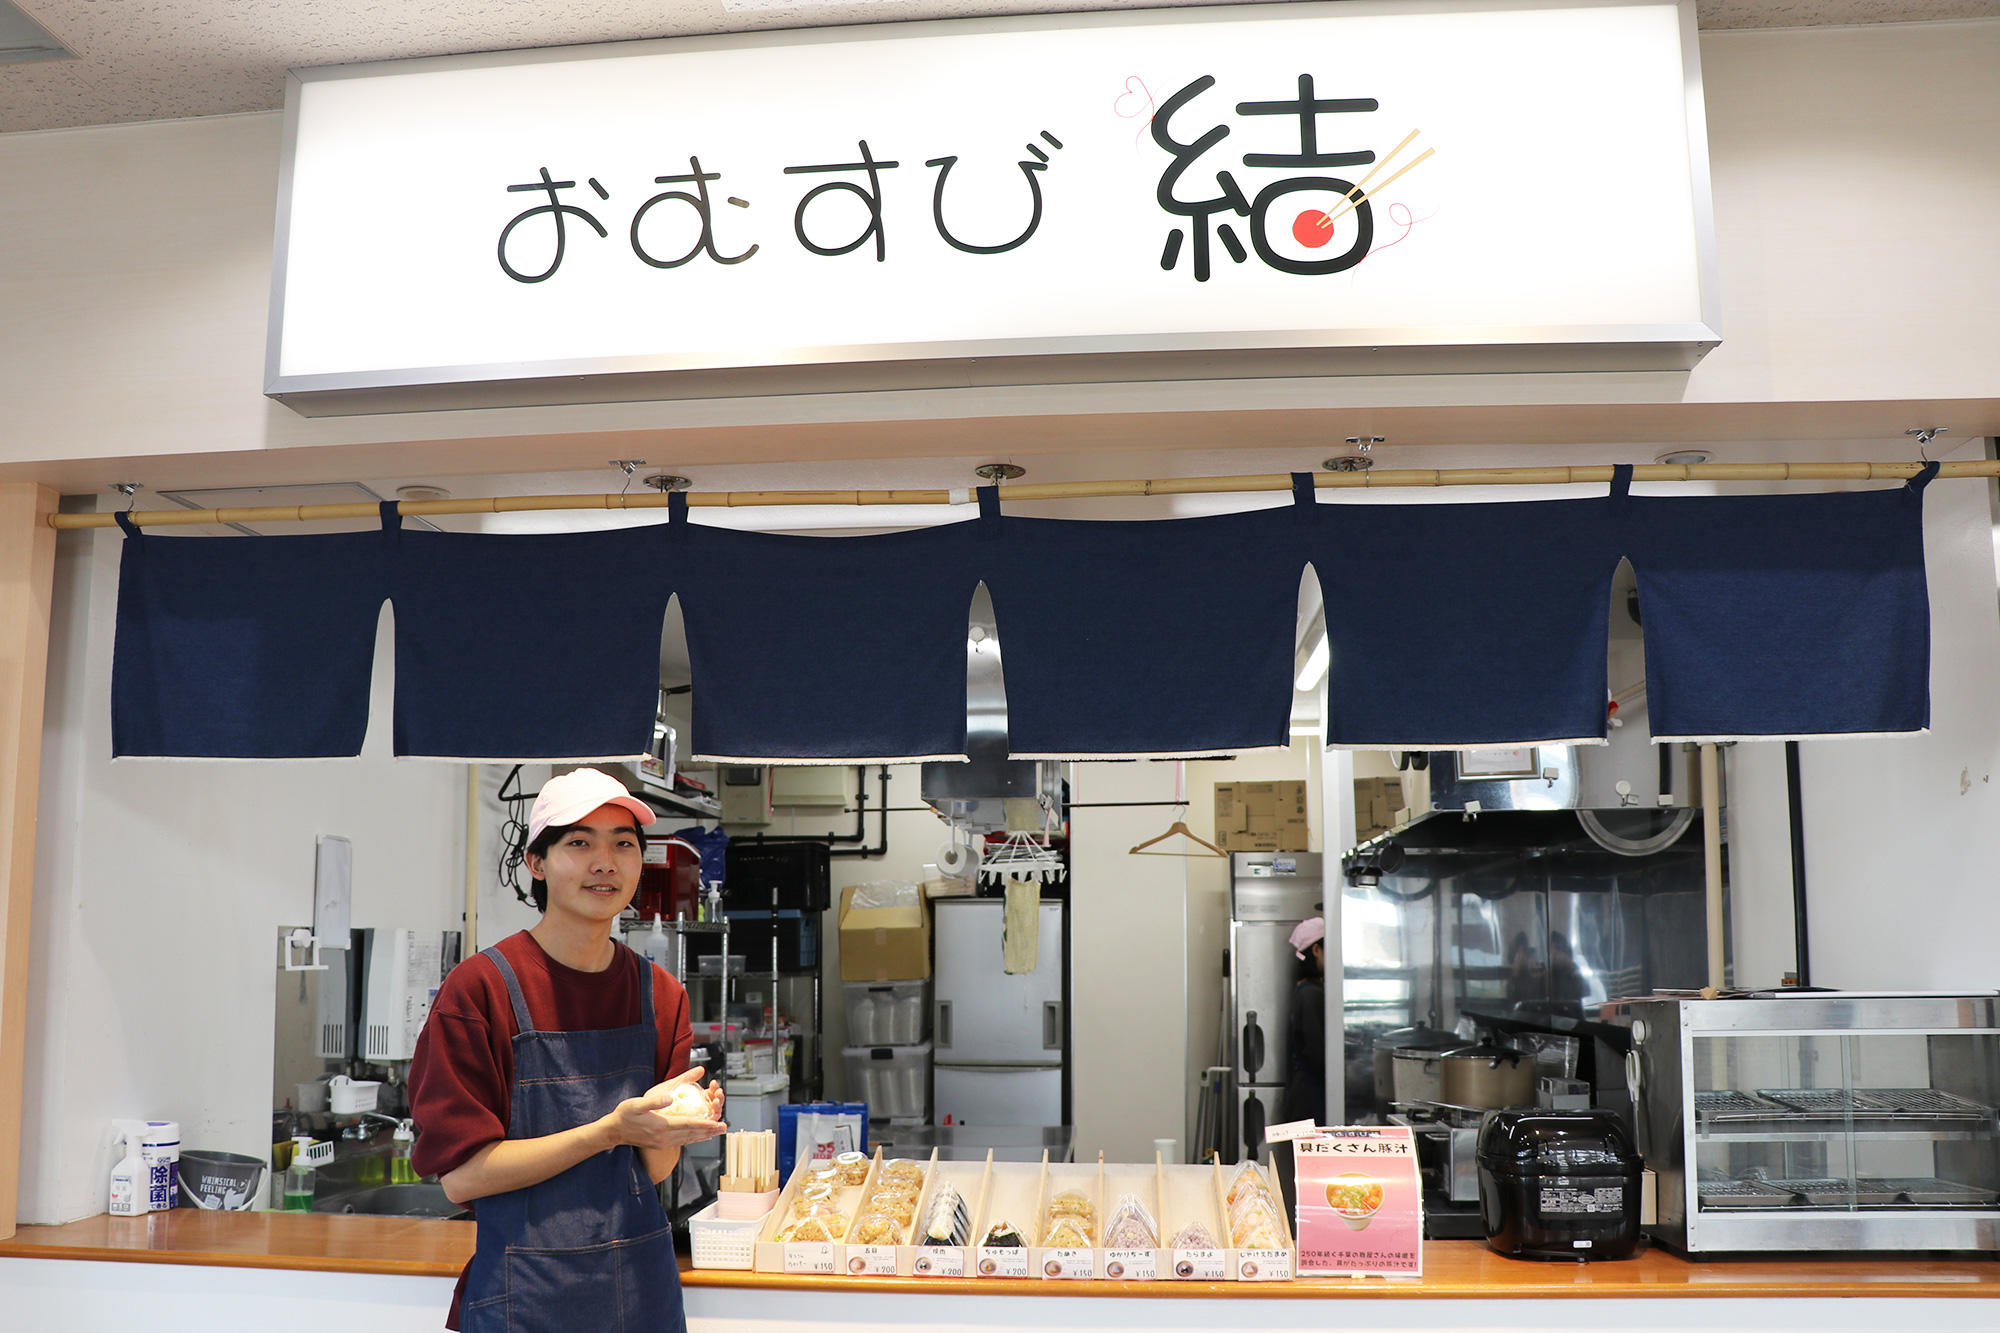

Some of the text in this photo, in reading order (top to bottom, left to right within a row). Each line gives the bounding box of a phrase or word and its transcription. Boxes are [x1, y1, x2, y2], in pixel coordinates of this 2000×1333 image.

[498, 74, 1378, 283] おむすび 結
[1299, 1142, 1408, 1154] 具だくさん豚汁
[150, 1165, 169, 1202] 除菌
[202, 1175, 237, 1187] WHIMSICAL
[200, 1184, 226, 1195] FEELING
